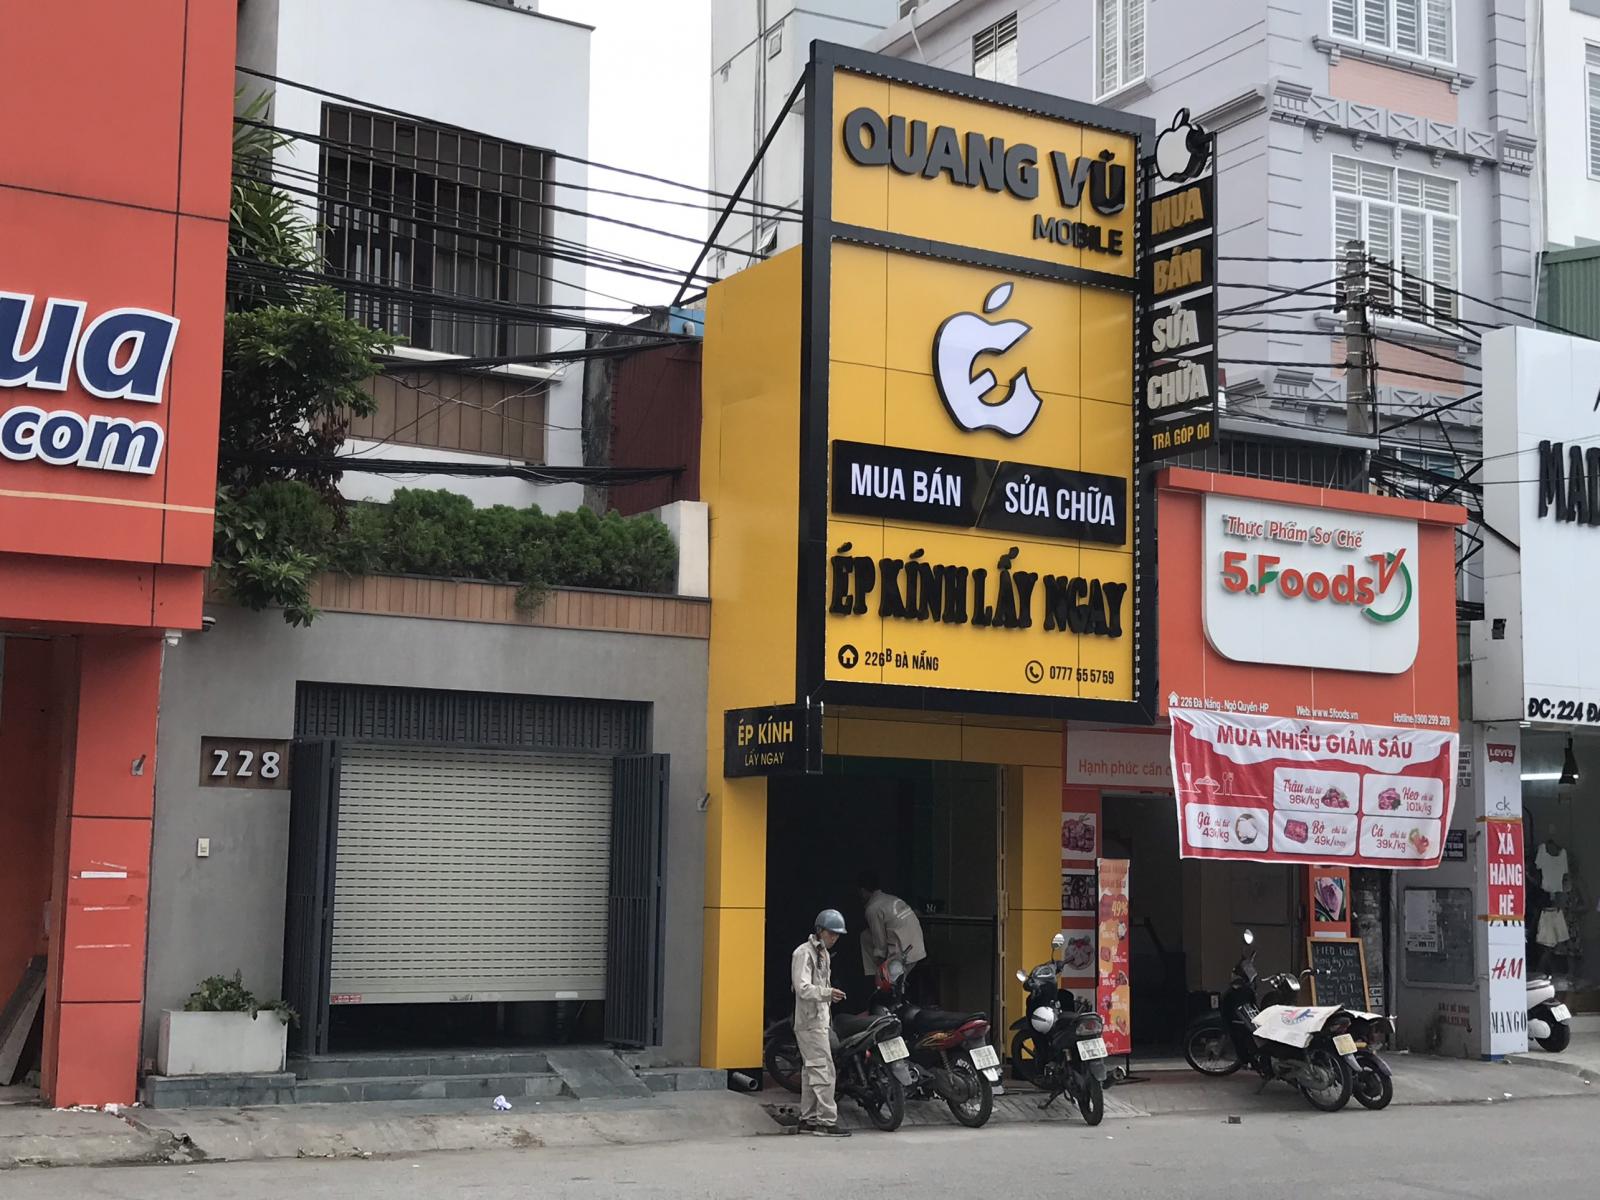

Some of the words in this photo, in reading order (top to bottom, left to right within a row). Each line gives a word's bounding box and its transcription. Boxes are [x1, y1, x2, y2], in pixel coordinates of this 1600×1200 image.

[843, 107, 1039, 200] QUANG
[1151, 187, 1204, 236] MUA
[1032, 214, 1123, 256] MOBILE
[1153, 246, 1202, 295] BÁN
[1152, 301, 1199, 353] SỬA
[1147, 359, 1209, 410] CHỮA
[1152, 426, 1171, 450] TRẢ
[1174, 423, 1194, 445] GÓP
[851, 462, 905, 501] MUA
[913, 467, 962, 507] BÁN
[1004, 474, 1050, 518] SỬA
[1056, 486, 1115, 526] CHỮA
[1225, 515, 1264, 541] Thực
[1269, 521, 1309, 542] Phẩm
[1314, 526, 1332, 545] Sơ
[1337, 529, 1364, 549] Chế
[829, 541, 876, 616] ÉP
[878, 548, 969, 624] KÍNH
[971, 546, 1038, 629] LẤY
[1043, 574, 1127, 638] NGAY
[895, 651, 909, 669] ĐÀ
[912, 650, 939, 671] NẴNG
[1049, 665, 1073, 681] 0777
[1181, 696, 1192, 707] 226
[1587, 702, 1600, 722] Đ
[737, 718, 754, 746] ÉP
[758, 715, 793, 745] KÍNH
[1217, 725, 1262, 748] MUA
[1266, 725, 1321, 752] NHIỀU
[1326, 731, 1373, 756] GIẢM
[1378, 735, 1413, 759] SÂU
[211, 750, 280, 779] 228
[745, 748, 759, 767] LẤY
[760, 752, 784, 766] NGAY
[1079, 759, 1107, 776] Hạnh
[1111, 760, 1139, 776] phúc
[1497, 823, 1515, 855] XẢ
[1489, 858, 1523, 886] HÀNG
[1498, 889, 1515, 916] HÈ
[1491, 958, 1524, 979] H&M
[1491, 1010, 1527, 1033] MANGO
